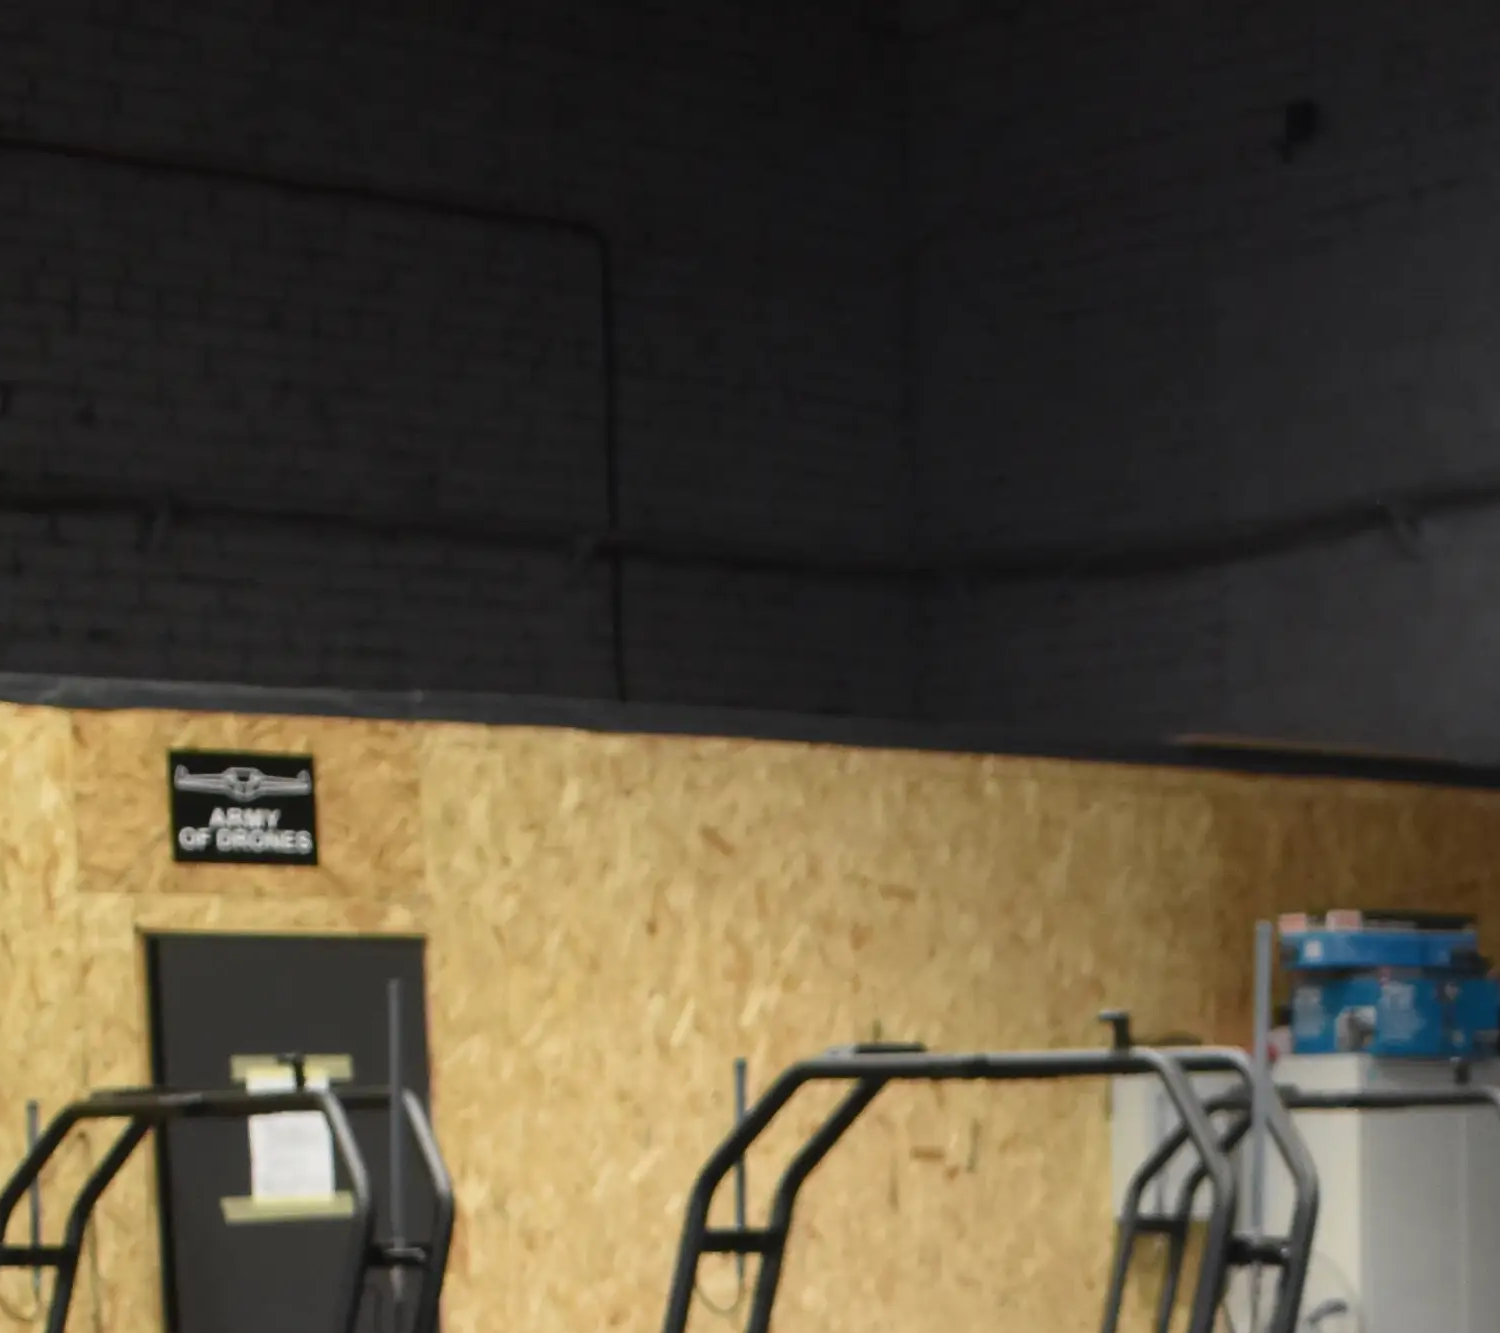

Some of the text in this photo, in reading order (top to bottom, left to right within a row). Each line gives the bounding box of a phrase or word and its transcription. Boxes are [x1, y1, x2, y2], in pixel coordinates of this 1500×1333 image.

[209, 807, 282, 828] ARMY
[179, 826, 313, 854] OF DRONES
